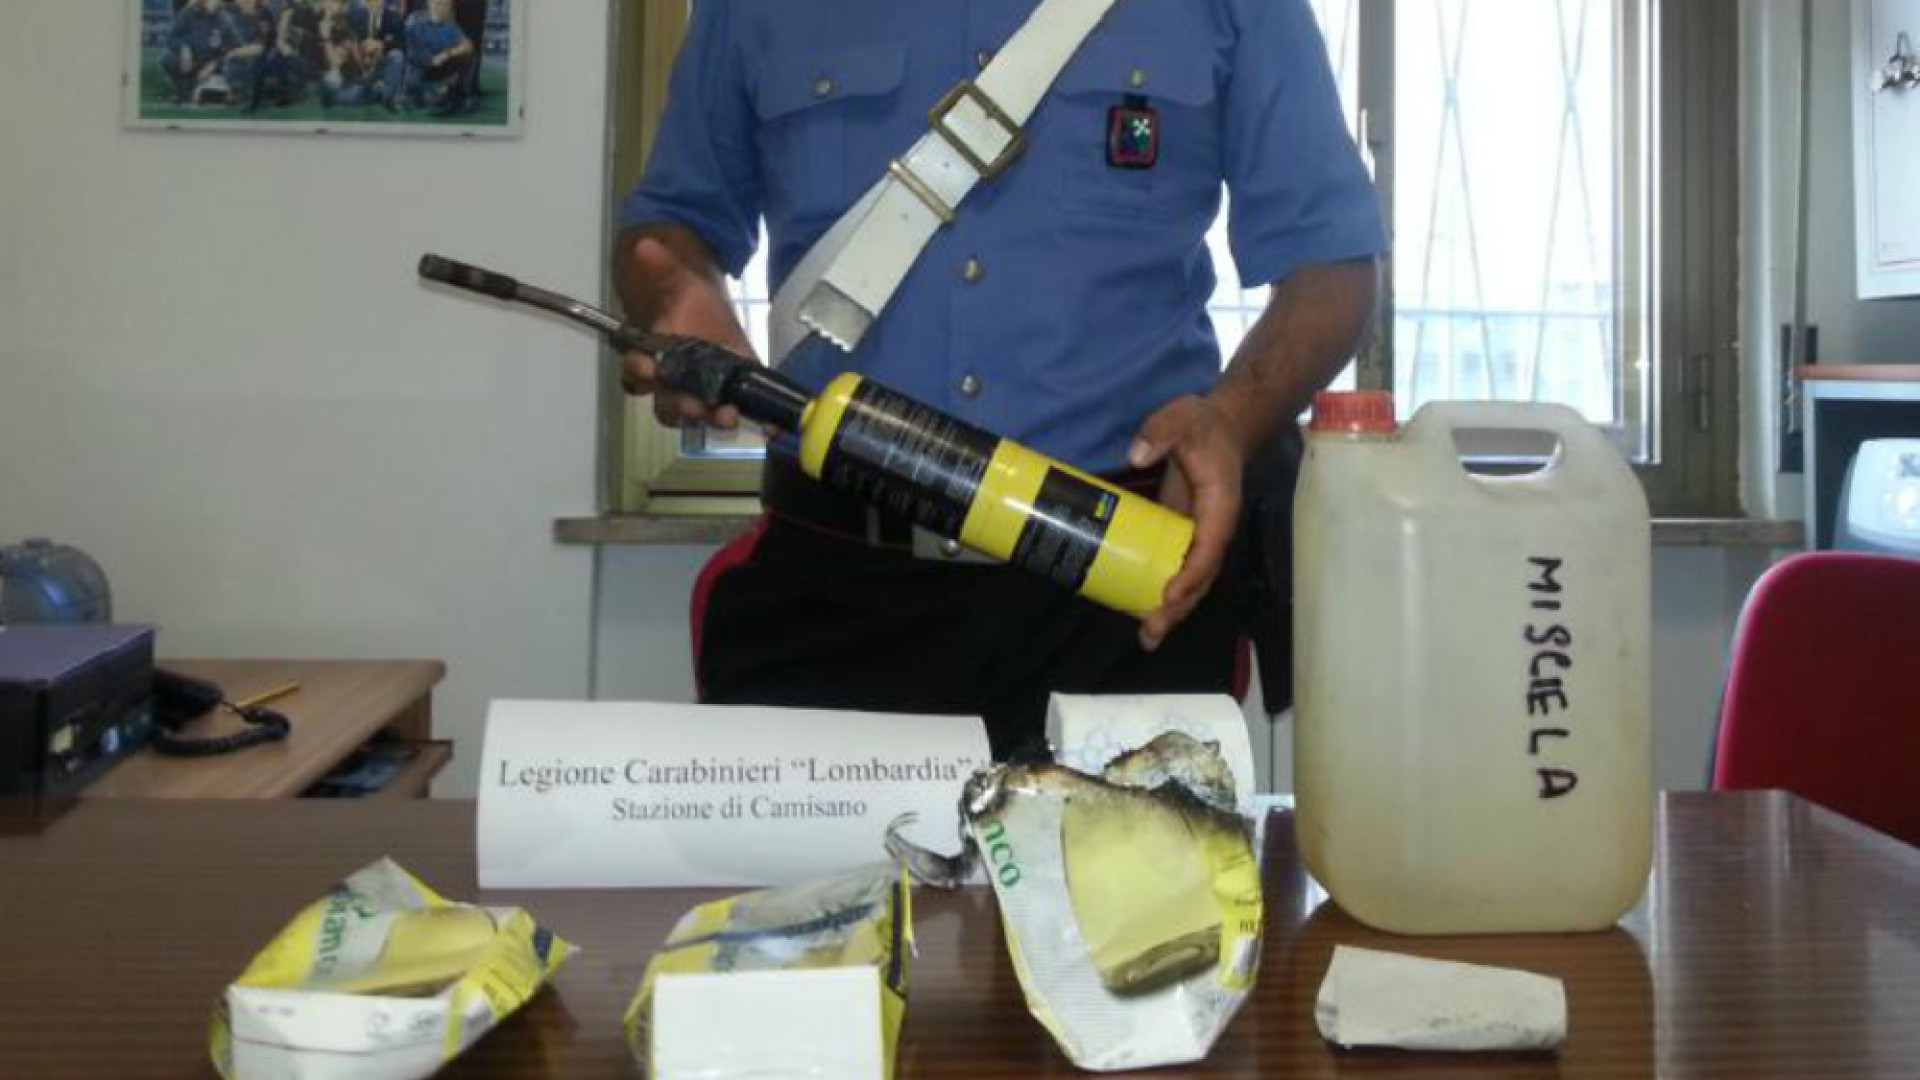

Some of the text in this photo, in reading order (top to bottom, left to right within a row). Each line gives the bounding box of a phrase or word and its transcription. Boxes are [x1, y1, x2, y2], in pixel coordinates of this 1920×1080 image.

[499, 756, 972, 793] Legione Carabinieri “Lombardia”
[612, 795, 867, 821] Stazione di Camisano
